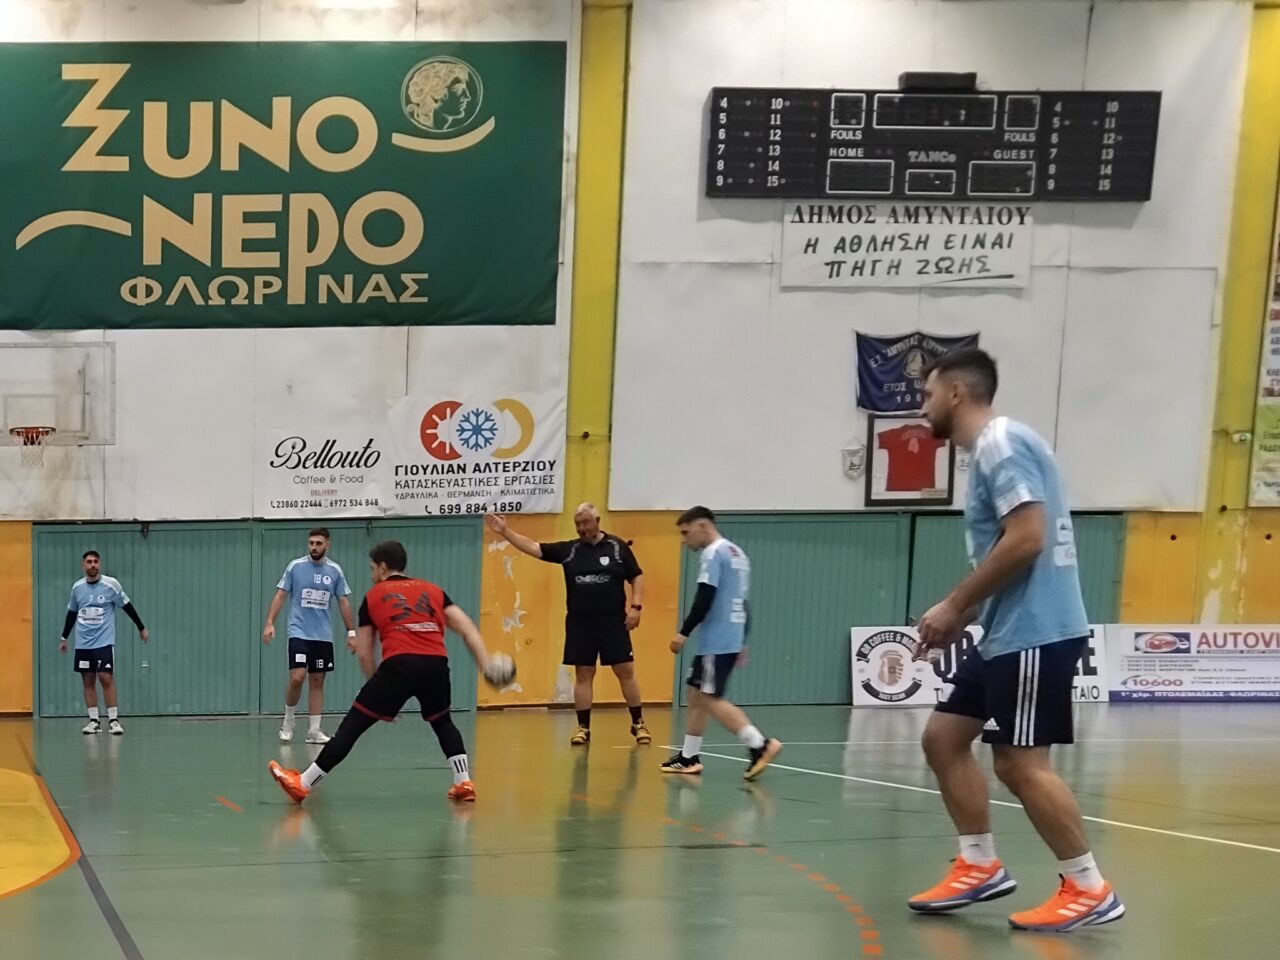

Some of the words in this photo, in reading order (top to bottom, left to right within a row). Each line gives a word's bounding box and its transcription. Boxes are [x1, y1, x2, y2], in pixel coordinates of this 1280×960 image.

[721, 97, 727, 108] 4
[771, 98, 783, 109] 10
[1054, 102, 1061, 112] 4
[1106, 102, 1119, 112] 10
[720, 113, 726, 124] 5
[770, 114, 780, 124] 11
[1053, 117, 1060, 127] 5
[1105, 118, 1115, 128] 11
[719, 129, 726, 139] 6
[770, 130, 781, 140] 12
[831, 130, 862, 140] FOULS
[1004, 132, 1036, 142] FOULS
[1051, 133, 1058, 143] 6
[1103, 133, 1115, 143] 12
[718, 144, 725, 155] 7
[769, 145, 780, 156] 13
[830, 148, 864, 157] HOME
[994, 150, 1034, 159] GUEST
[1050, 149, 1057, 159] 7
[1102, 149, 1113, 159] 13
[717, 160, 724, 170] 8
[768, 161, 779, 171] 14
[1049, 164, 1056, 174] 8
[1100, 164, 1112, 175] 14
[716, 175, 723, 186] 9
[767, 176, 779, 187] 15
[1048, 179, 1055, 190] 9
[1098, 180, 1110, 190] 15
[790, 205, 877, 224] ΔΗΜΟΣ
[886, 206, 1031, 225] ΑΜΥΝΤΑΙΟΥ
[803, 237, 819, 254] Η
[834, 233, 929, 254] ΑΘΛΗΣΗ
[944, 233, 1013, 250] ΕΙΝΑΙ
[825, 259, 902, 279] ΠΗΓΗ
[916, 256, 991, 275] ΖΩΗΣ
[270, 436, 380, 470] Bellouto
[395, 463, 466, 476] ΓΙΟΥΛΙΑΝ
[472, 460, 556, 474] ΑΛΤΕΡΖΙΟΥ
[293, 475, 326, 484] Coffee
[340, 475, 364, 484] Food
[395, 476, 500, 489] ΚΑΤΑΣΚΕΥΑΣΤΙΚΕΣ
[504, 475, 555, 486] ΕΡΓΑΣΙΕΣ
[395, 491, 438, 500] ΥΔΡΑΥΛΙΚΑ
[448, 490, 492, 498] ΘΕΡΜΑΝΣΗ
[500, 488, 554, 496] ΚΛΙΜΑΤΙΣΤΙΚΑ
[330, 499, 347, 507] 6972
[350, 499, 362, 507] 534
[439, 504, 462, 514] 699
[466, 503, 487, 514] 884
[493, 502, 522, 512] 1850
[314, 574, 321, 583] 18
[382, 592, 436, 623] 34
[869, 632, 894, 647] COFFEE
[316, 659, 323, 668] 18
